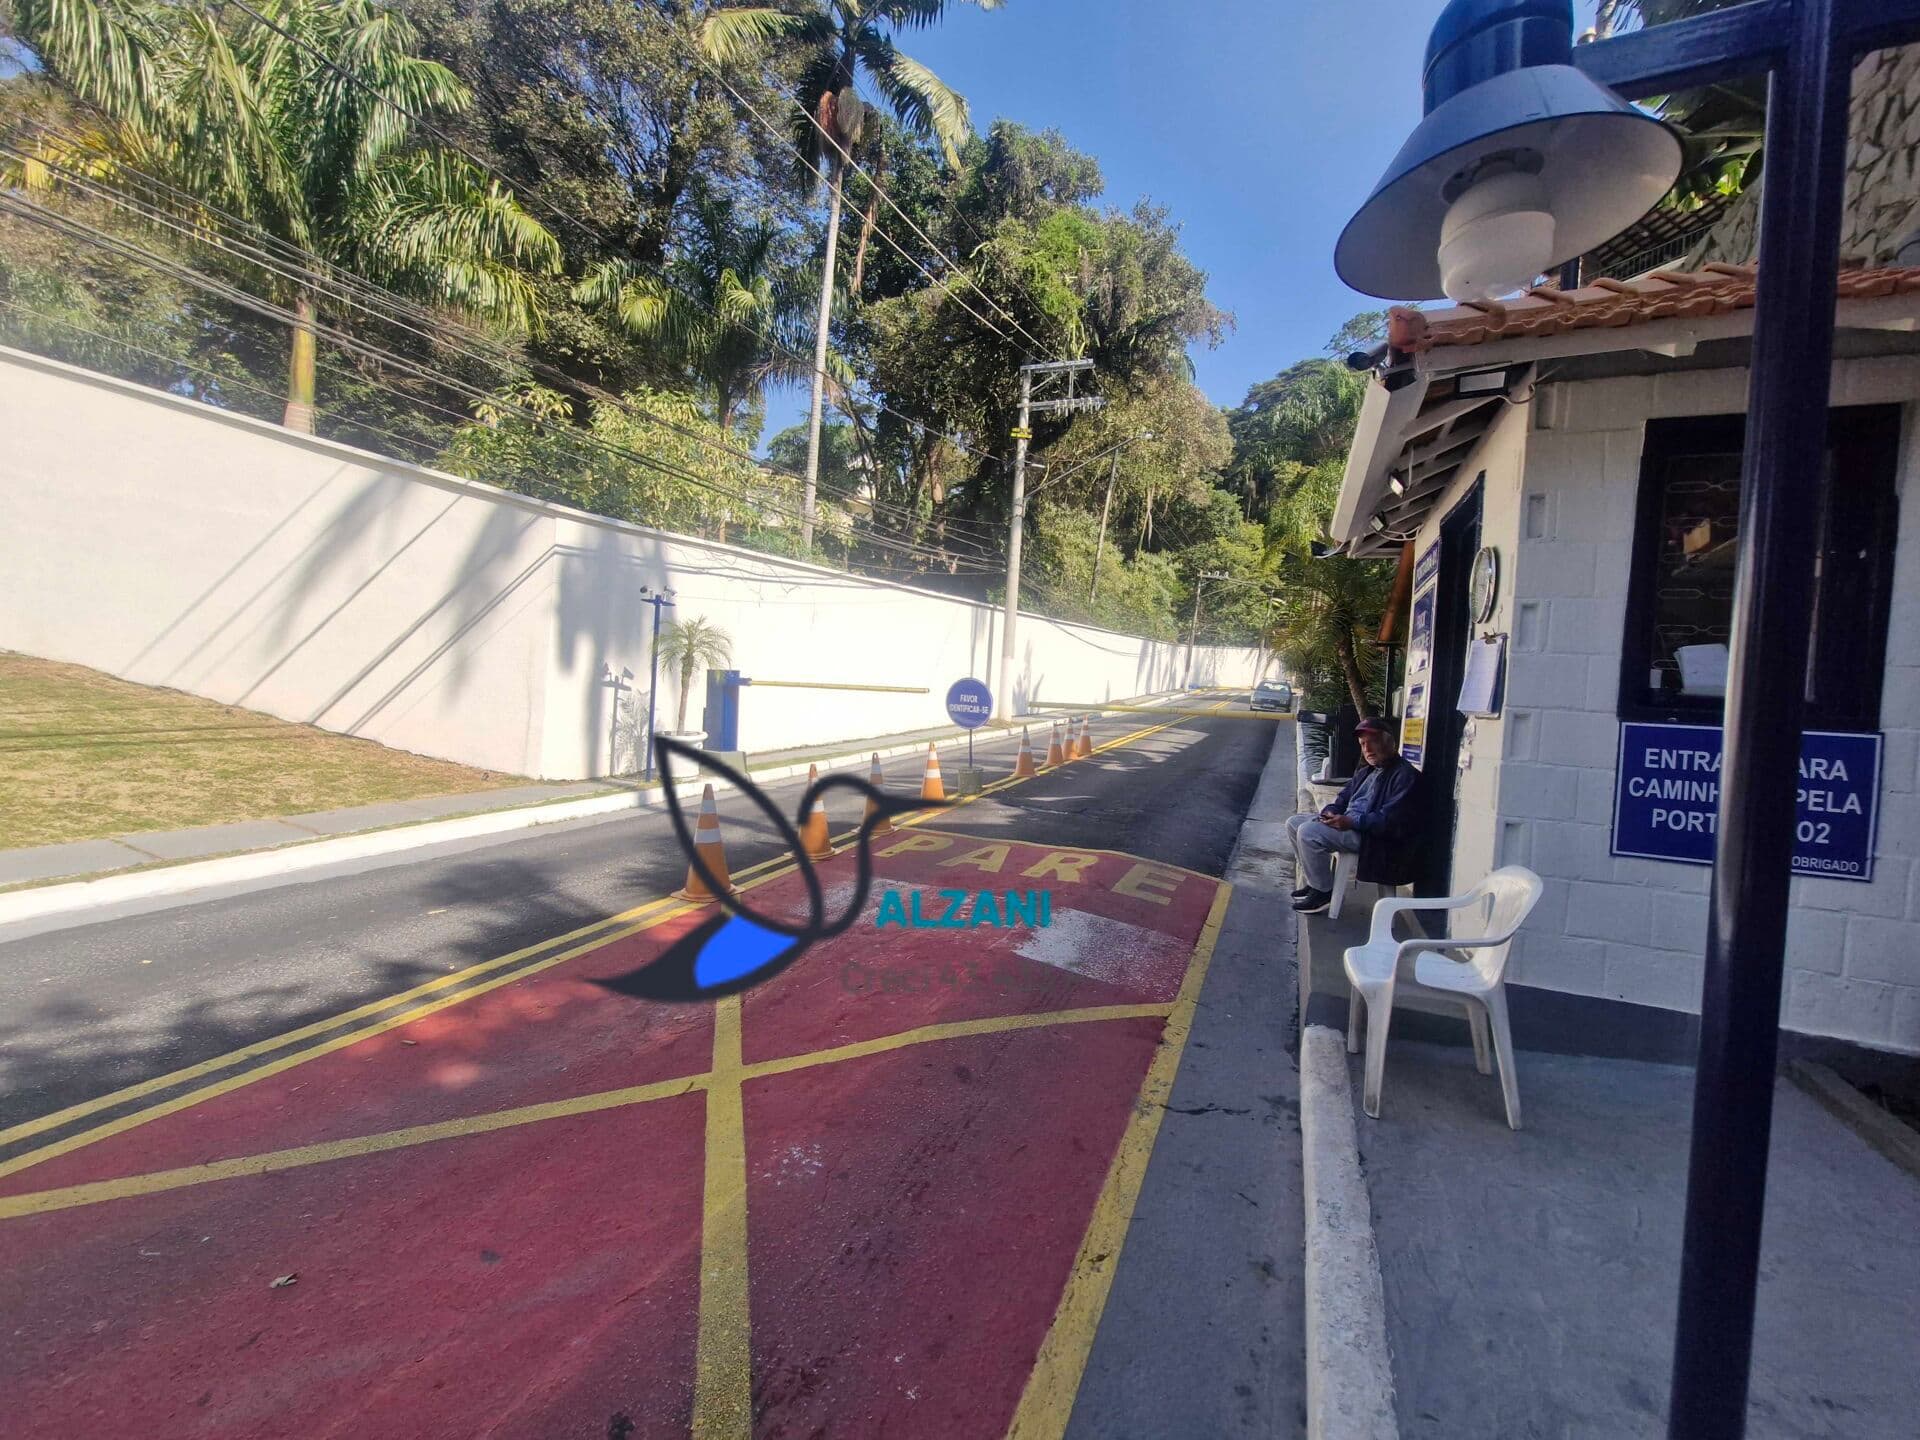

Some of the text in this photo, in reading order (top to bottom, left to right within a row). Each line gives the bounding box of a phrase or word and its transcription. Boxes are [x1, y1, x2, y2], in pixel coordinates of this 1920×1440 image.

[960, 694, 978, 704] FAVOR
[1645, 748, 1849, 781] ENTRA ARA
[1629, 777, 1719, 802] CAMINH
[1651, 808, 1718, 834] PORT
[873, 834, 1188, 905] PARE
[1791, 855, 1859, 873] OBRIGADO
